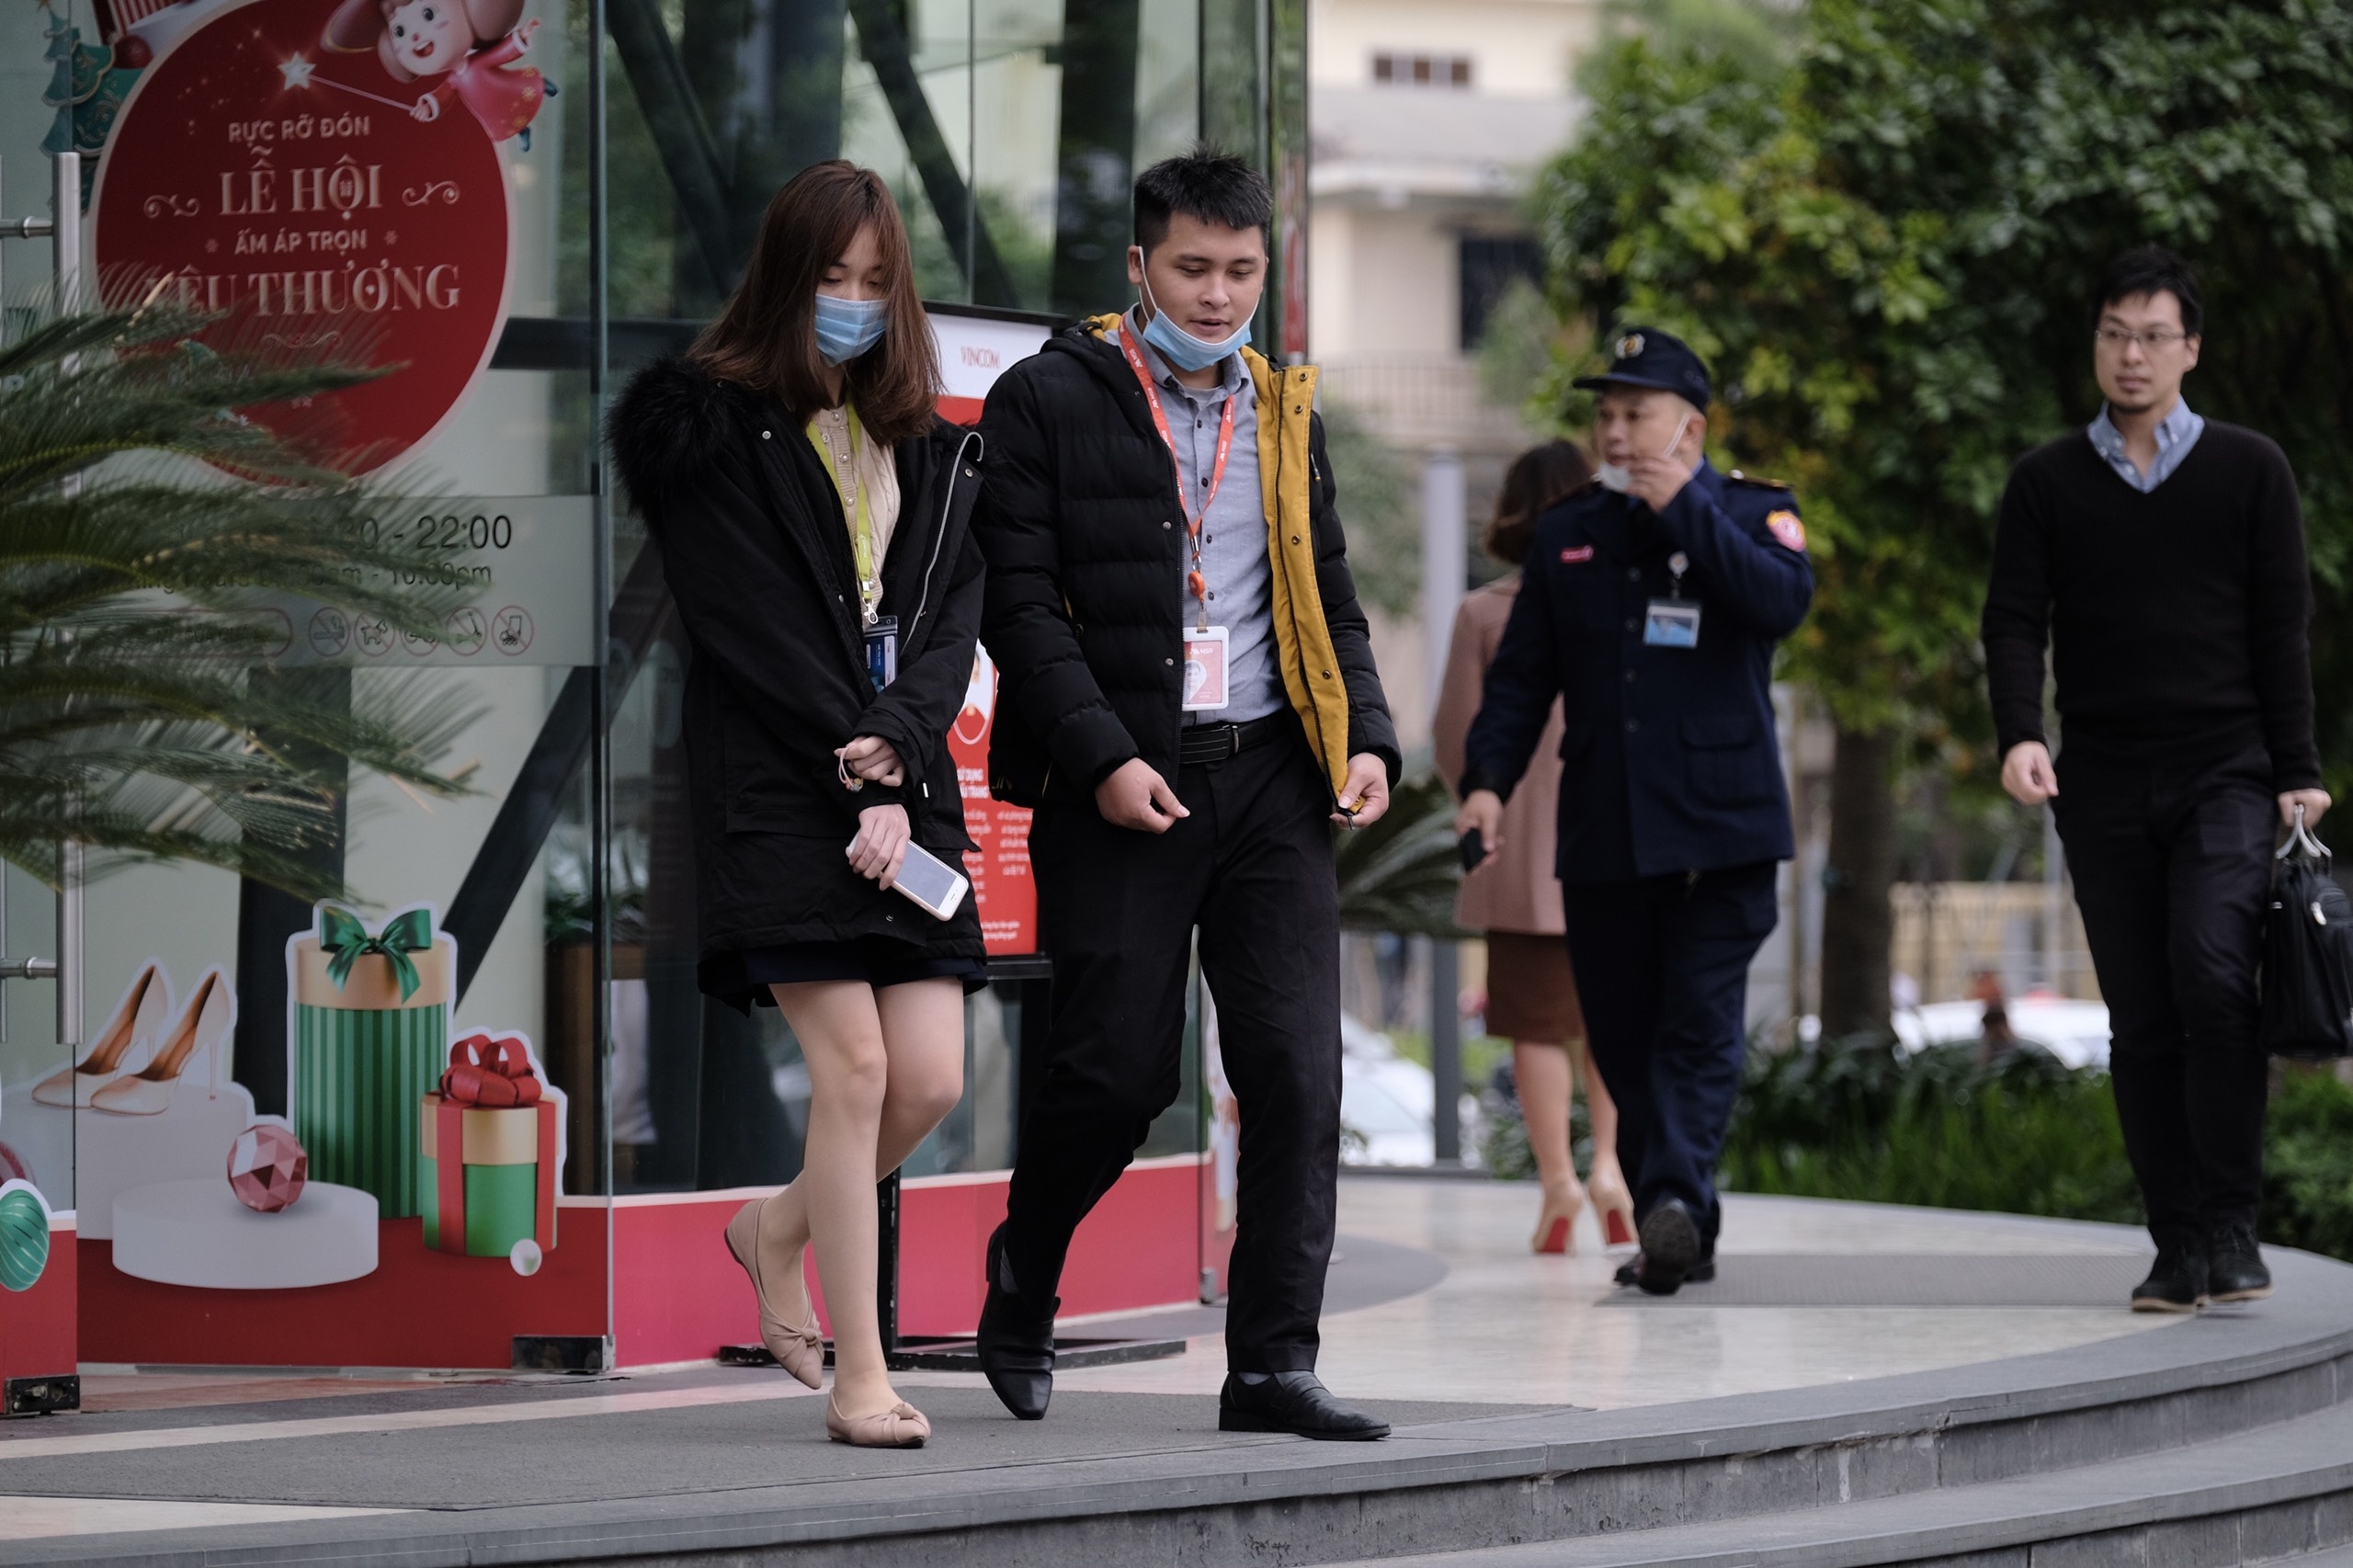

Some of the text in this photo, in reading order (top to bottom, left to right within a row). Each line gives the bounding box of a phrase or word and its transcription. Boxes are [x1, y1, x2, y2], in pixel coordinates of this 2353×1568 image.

[229, 111, 371, 147] RỰC RỠ ĐÓN
[220, 145, 383, 221] LỄ HỘI
[234, 227, 368, 257] ẤM ÁP TRỌN
[248, 258, 460, 317] THƯƠNG
[961, 346, 1000, 369] VINCOM
[416, 515, 512, 550] 22:00
